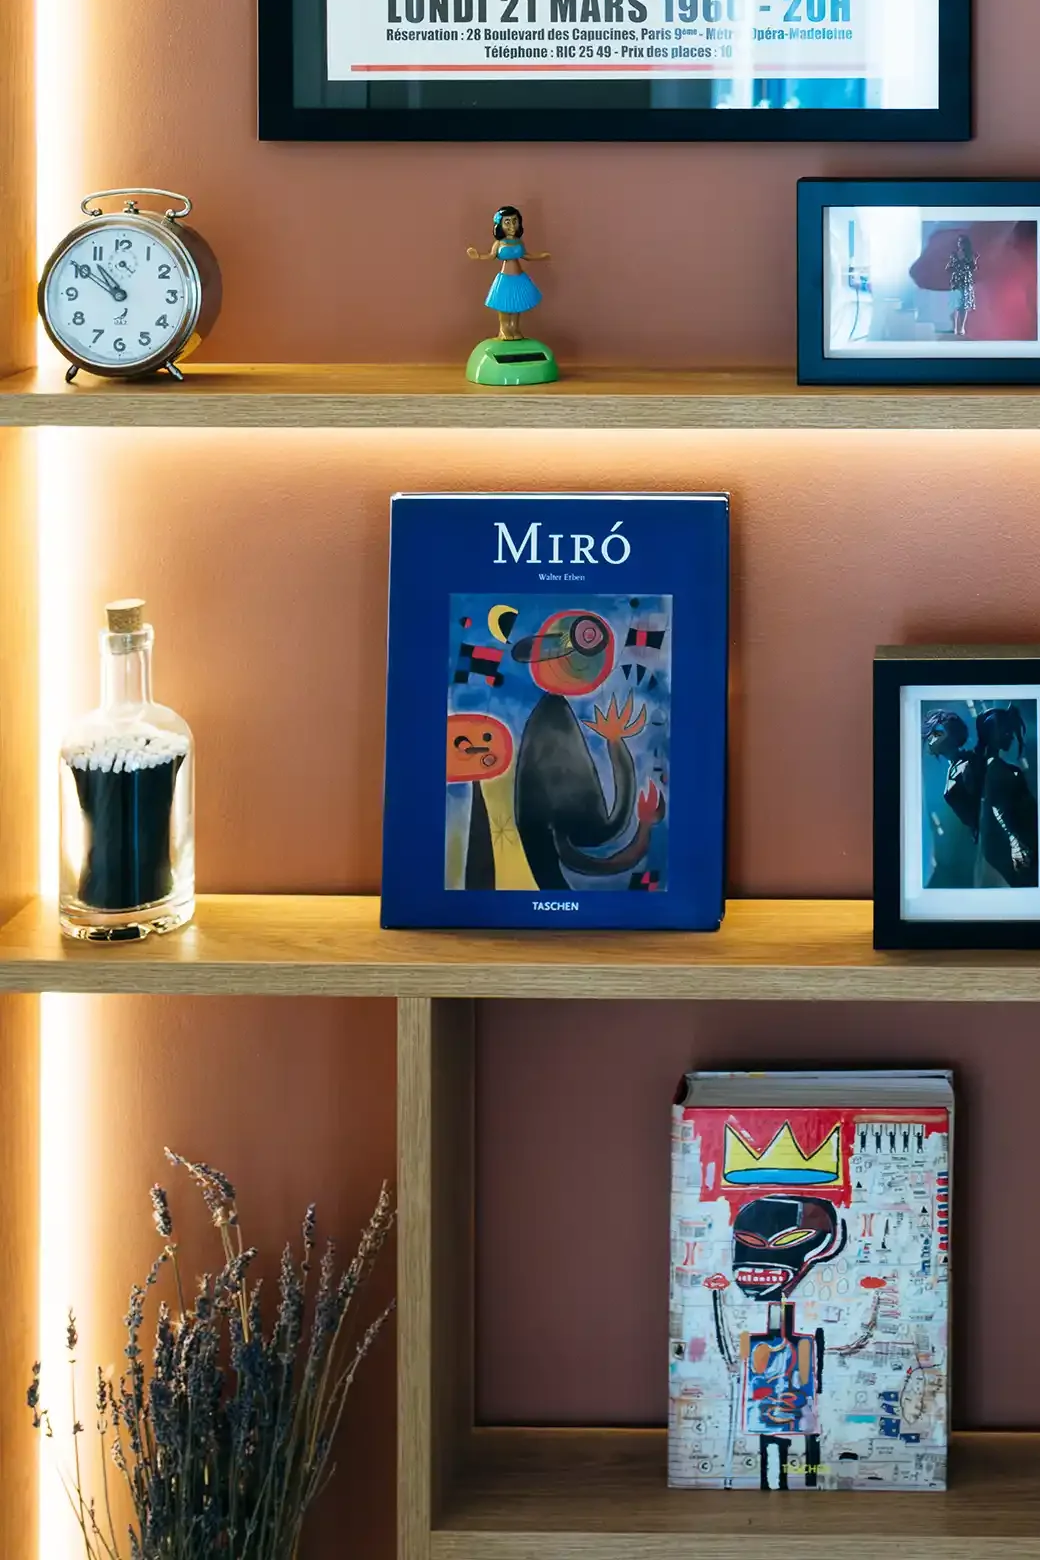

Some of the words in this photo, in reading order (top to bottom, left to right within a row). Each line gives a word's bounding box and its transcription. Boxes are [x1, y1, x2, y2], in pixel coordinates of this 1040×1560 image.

[386, 27, 459, 41] Réservation
[466, 28, 481, 40] 28
[484, 27, 545, 41] Boulevard
[547, 27, 569, 41] des
[571, 27, 639, 42] Capucines,
[641, 27, 672, 40] Paris
[706, 26, 737, 40] Métr
[485, 45, 548, 59] Téléphone
[556, 46, 576, 58] RIC
[578, 46, 594, 58] 25
[596, 46, 612, 58] 49
[621, 45, 645, 58] Prix
[646, 45, 669, 58] des
[671, 45, 712, 59] places
[115, 239, 132, 252] 12
[93, 246, 103, 261] 11
[146, 246, 151, 261] 1
[74, 264, 91, 279] 10
[158, 264, 171, 280] 2
[65, 287, 78, 301] 9
[165, 289, 178, 305] 3
[72, 311, 85, 326] 8
[155, 314, 169, 329] 4
[91, 329, 105, 344] 7
[138, 331, 151, 347] 5
[113, 338, 126, 352] 6
[538, 573, 562, 582] Walter
[563, 573, 585, 582] Erben
[532, 901, 579, 912] TASCHEN
